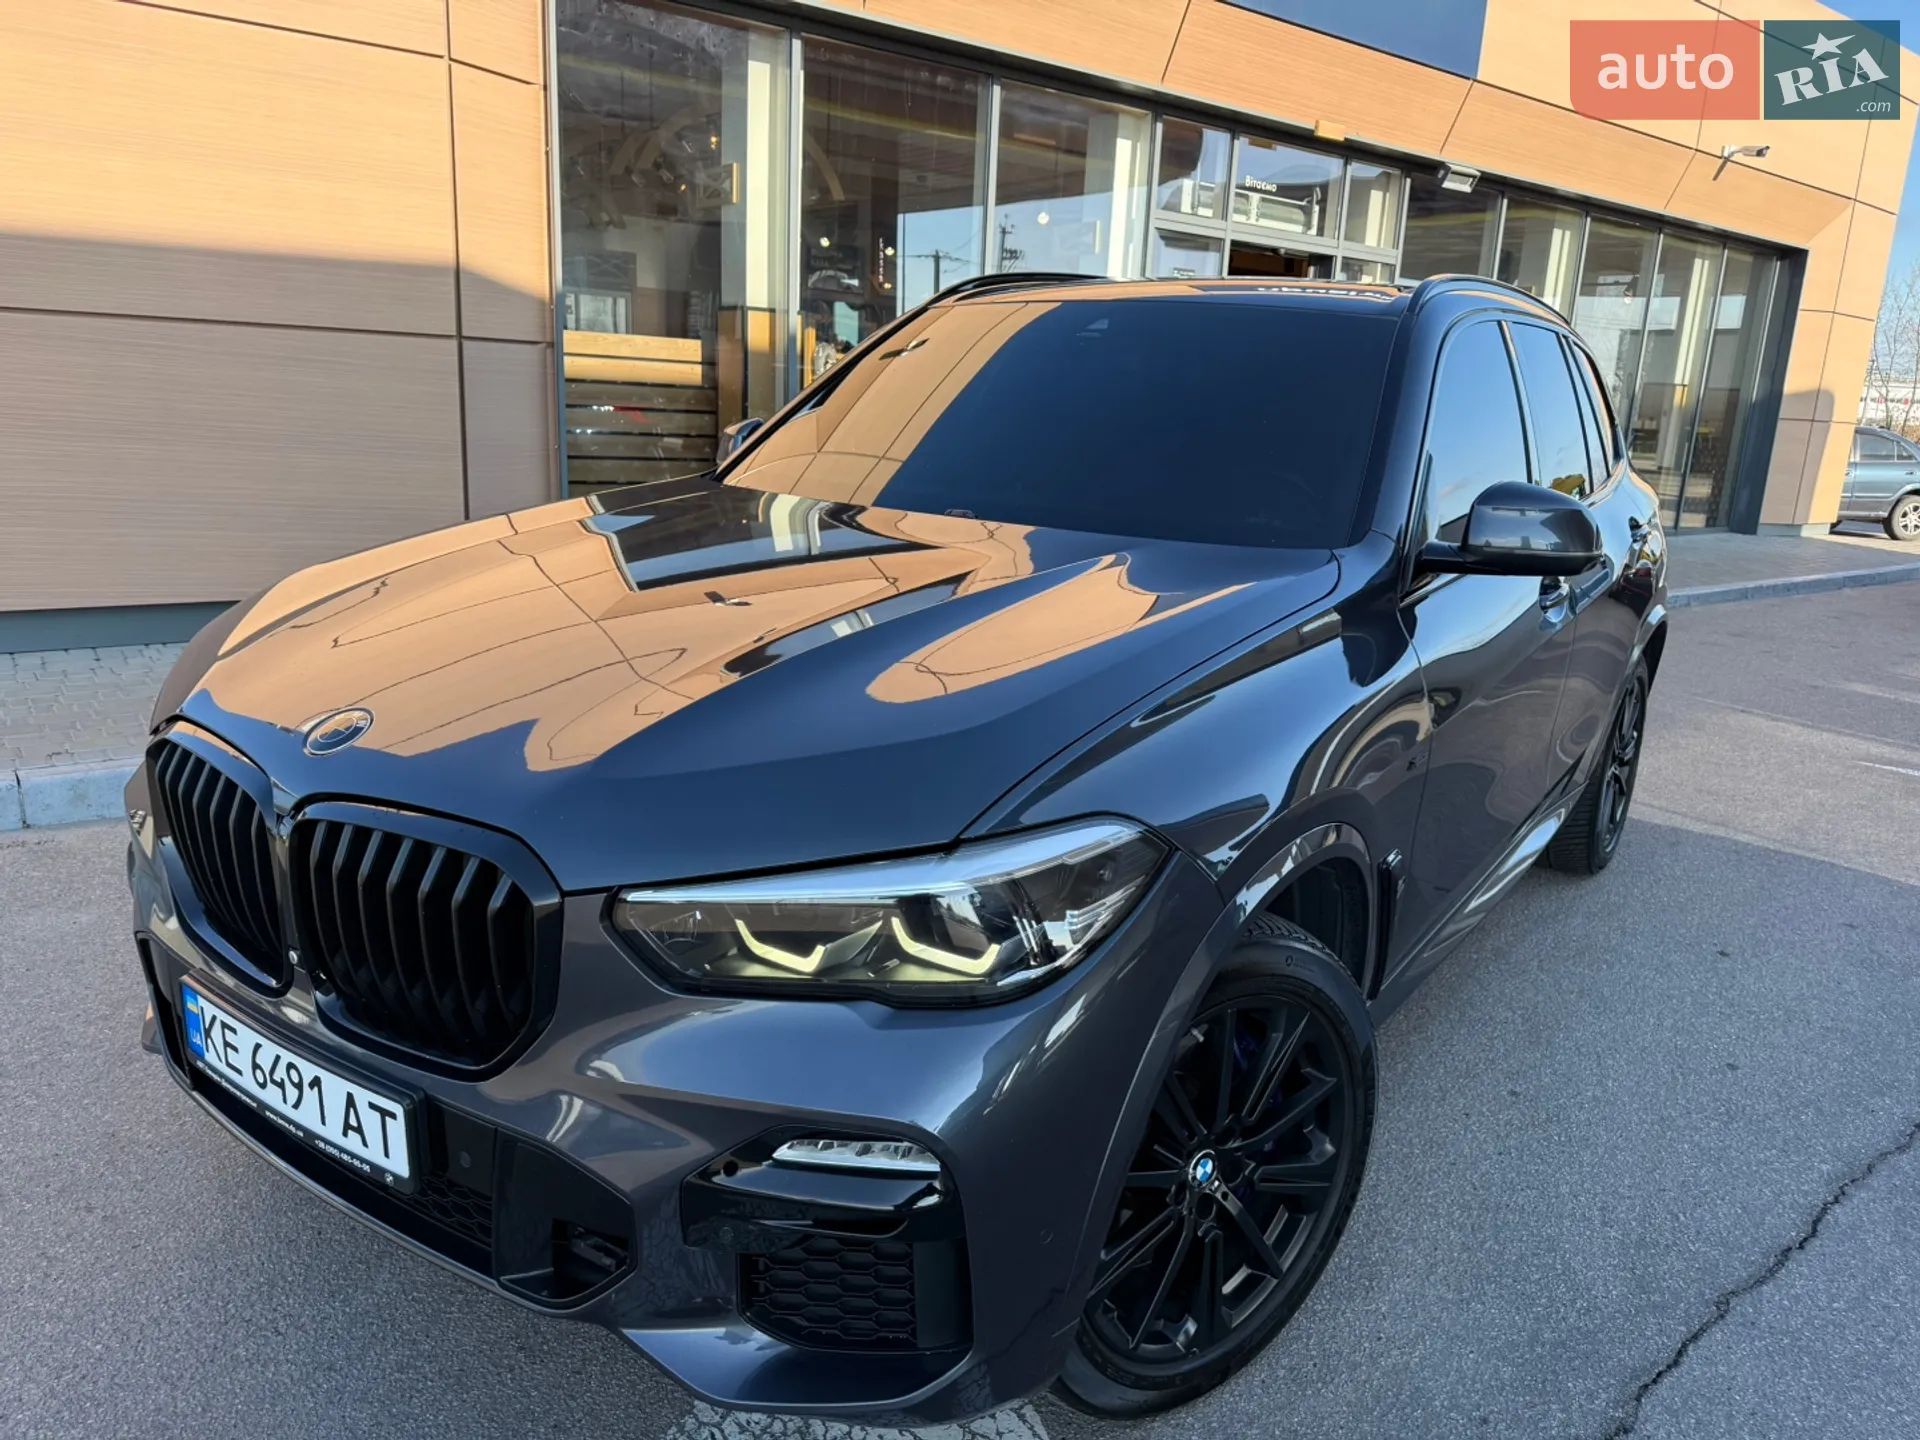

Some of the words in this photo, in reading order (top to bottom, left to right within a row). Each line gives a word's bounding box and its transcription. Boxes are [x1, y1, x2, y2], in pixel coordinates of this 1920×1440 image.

[190, 1027, 203, 1048] UA
[200, 1005, 244, 1078] KE
[251, 1041, 327, 1127] 6491
[342, 1090, 398, 1160] AT
